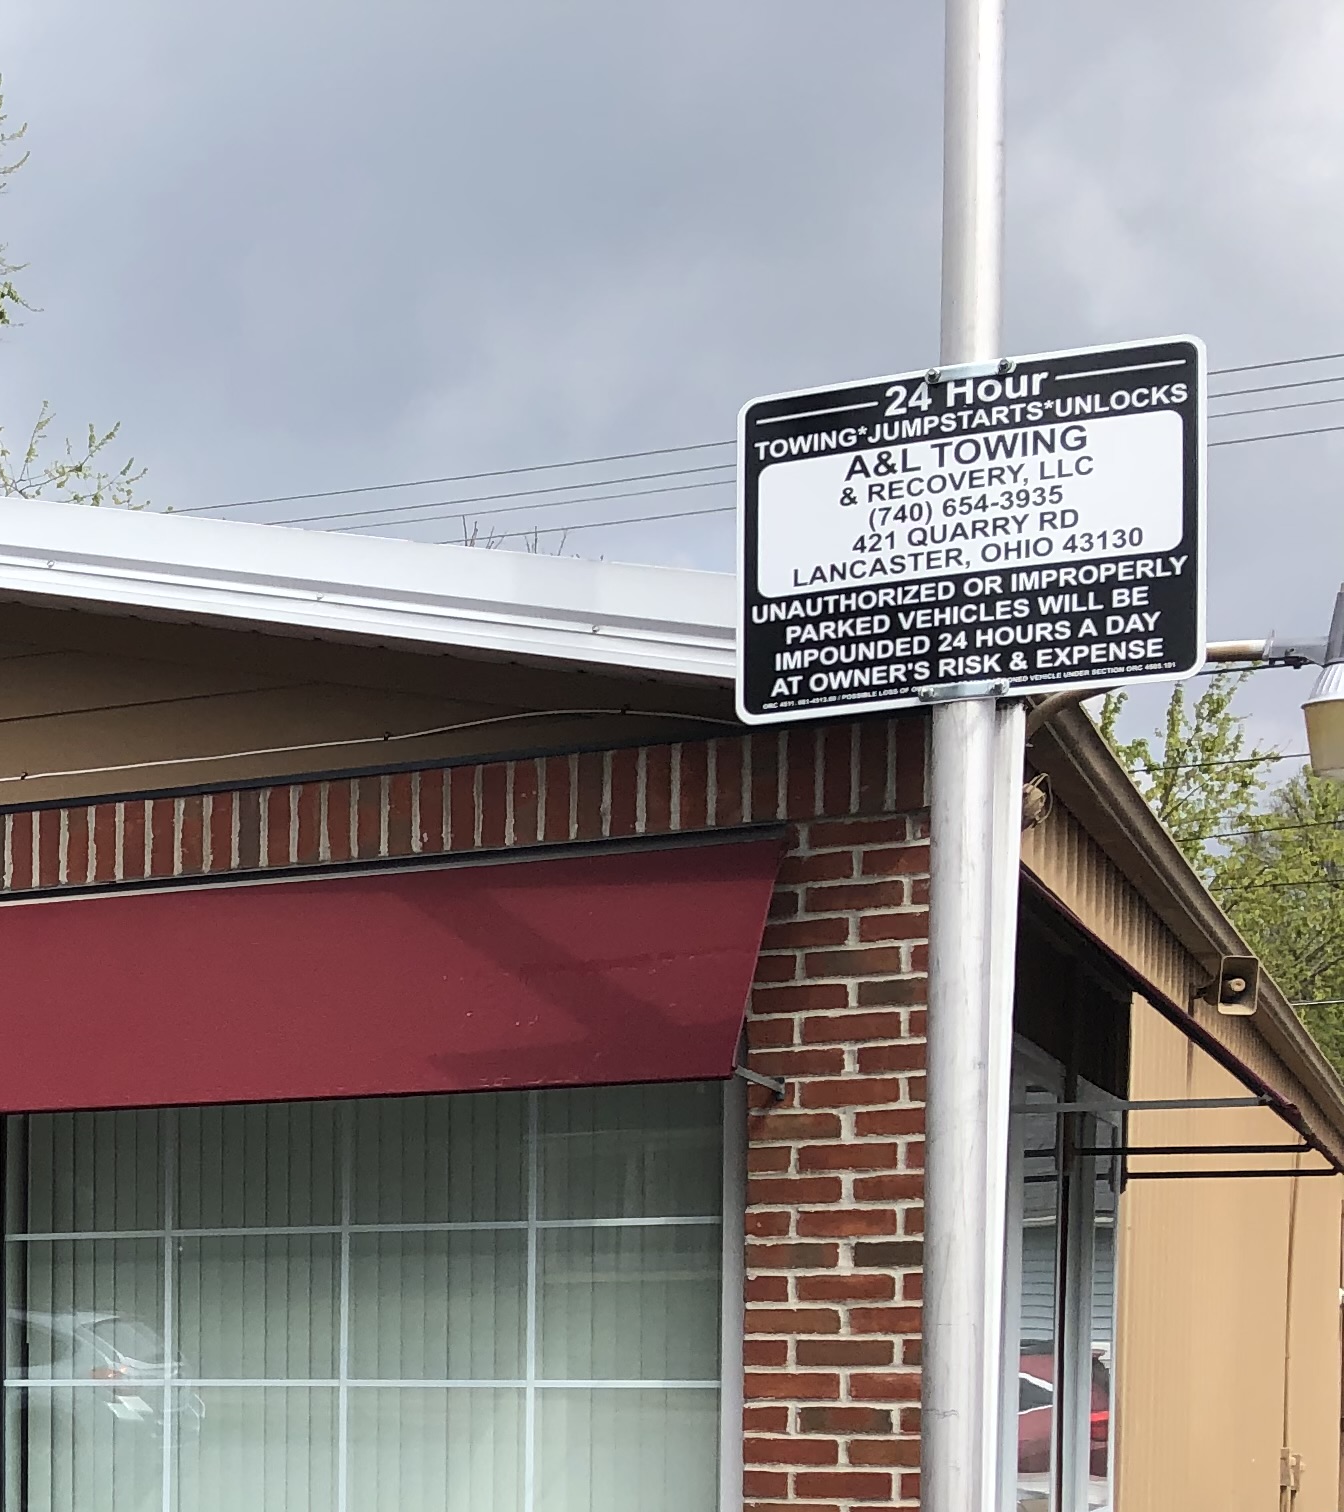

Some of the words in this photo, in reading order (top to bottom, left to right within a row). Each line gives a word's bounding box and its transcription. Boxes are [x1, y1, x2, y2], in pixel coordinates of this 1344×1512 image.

[885, 383, 932, 416] 24
[947, 372, 1047, 406] Hour
[845, 449, 922, 480] A&L
[931, 425, 1086, 468] TOWING
[840, 489, 857, 506] &
[868, 464, 1029, 503] RECOVERY,
[1040, 455, 1093, 480] LLC
[853, 533, 897, 553] 421
[907, 515, 1029, 547] QUARRY
[1039, 509, 1078, 530] RD
[870, 502, 932, 531] (740)
[943, 487, 1062, 518] 654-3935
[794, 548, 971, 587] LANCASTER,
[981, 537, 1052, 565] OHIO
[1063, 527, 1143, 554] 43130
[752, 582, 955, 624] UNAUTHORIZED
[964, 575, 1002, 596] OR
[1012, 556, 1188, 593] IMPROPERLY
[786, 615, 890, 644] PARKED
[899, 600, 1029, 630] VEHICLES
[1039, 591, 1104, 616] WILL
[1113, 586, 1149, 606] BE
[771, 677, 803, 697] AT
[809, 660, 929, 691] OWNER'S
[939, 651, 1000, 676] RISK
[1011, 649, 1028, 669] &
[1036, 639, 1164, 666] EXPENSE
[775, 637, 931, 671] IMPOUNDED
[938, 632, 968, 651] 24
[976, 620, 1070, 648] HOURS
[1078, 618, 1097, 638] A
[1106, 611, 1161, 635] DAY
[842, 690, 877, 701] POSSIBLE
[879, 688, 899, 697] LOSS
